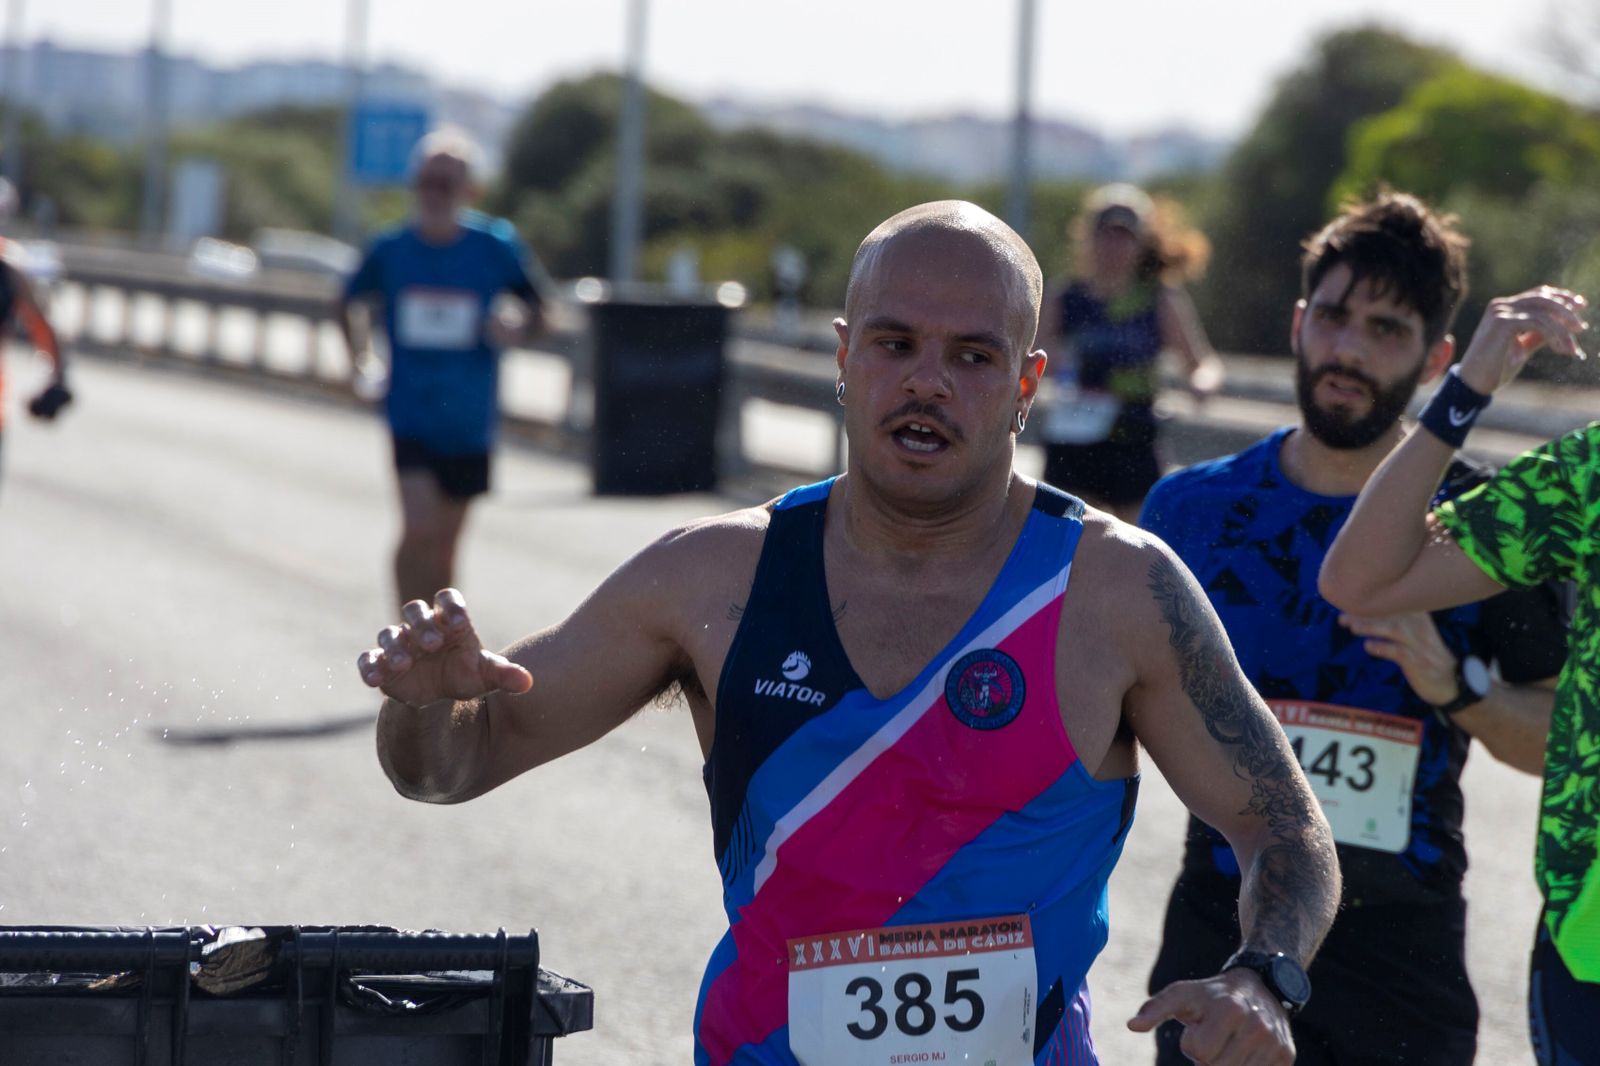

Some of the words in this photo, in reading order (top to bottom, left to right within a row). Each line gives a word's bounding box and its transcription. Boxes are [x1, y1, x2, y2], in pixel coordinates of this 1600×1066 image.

[754, 678, 826, 707] VIATOR
[879, 928, 937, 944] MEDIA
[943, 937, 967, 951] DE
[844, 967, 985, 1041] 385
[890, 1052, 929, 1065] SERGIO
[931, 1051, 946, 1062] MJ
